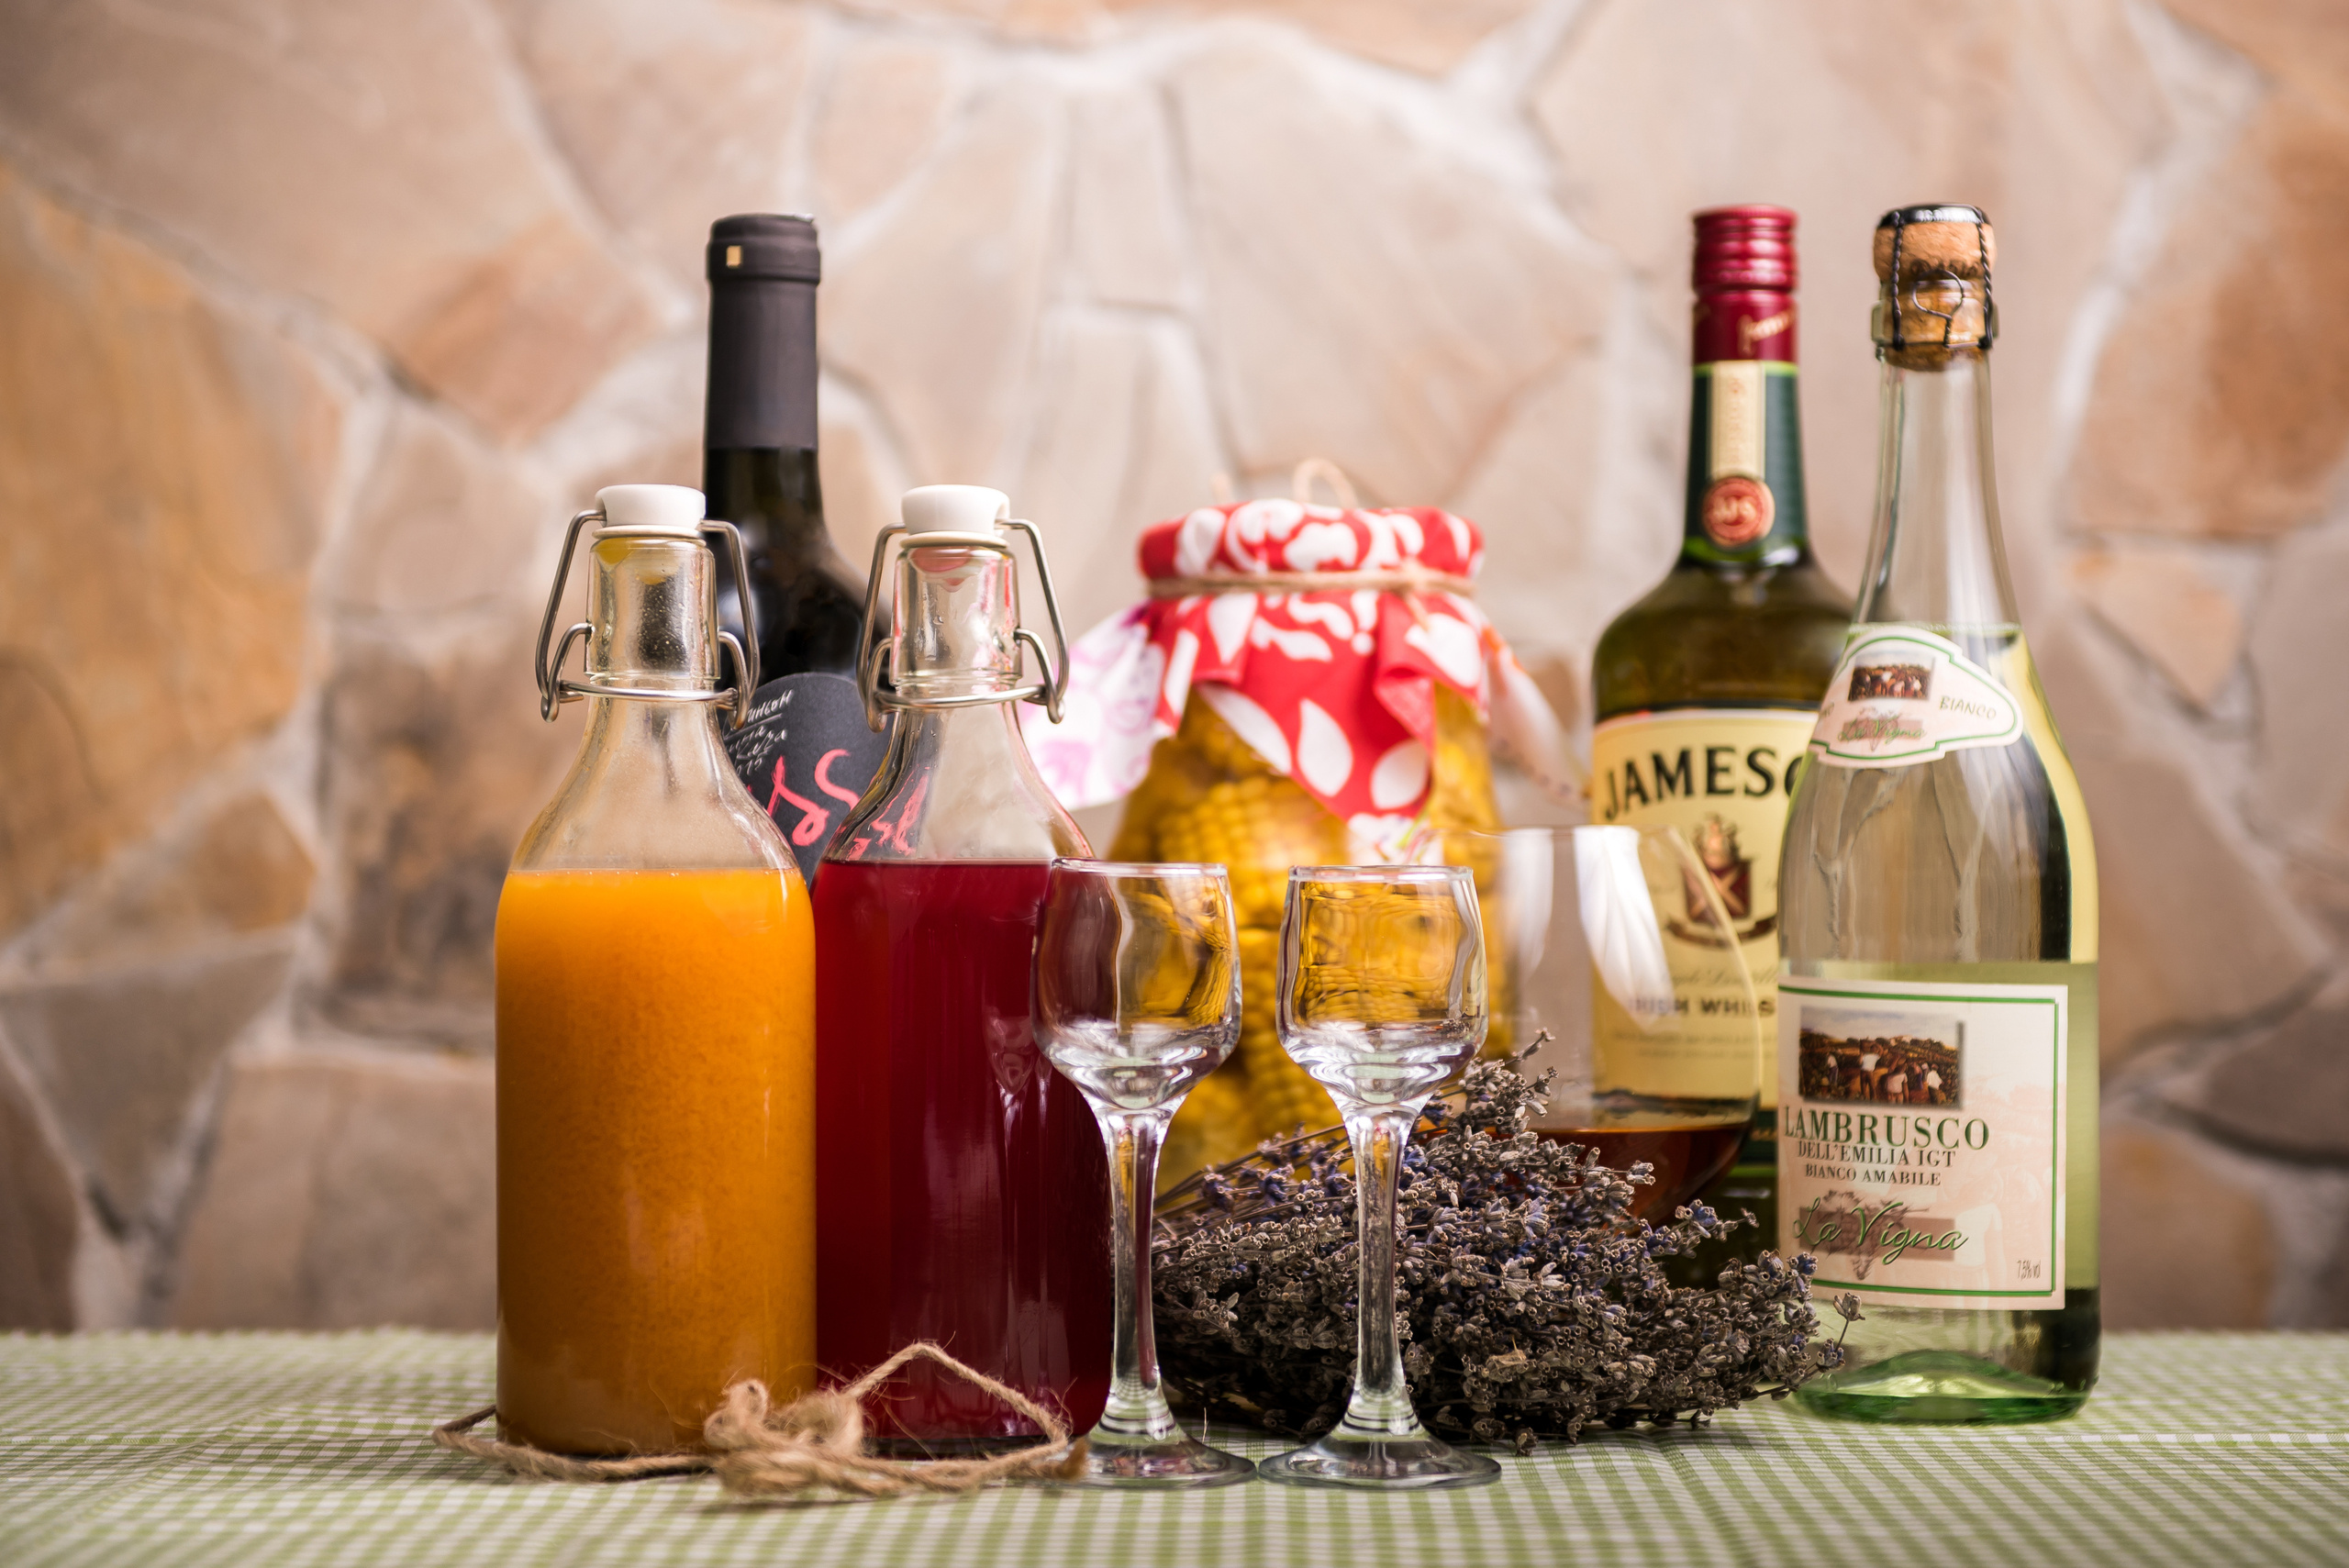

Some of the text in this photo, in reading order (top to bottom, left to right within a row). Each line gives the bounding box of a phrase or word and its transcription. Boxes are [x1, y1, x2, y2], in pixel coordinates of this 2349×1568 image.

[1939, 695, 1997, 721] BIANCO
[1837, 714, 1926, 745] La Vigna
[1700, 997, 1776, 1018] WHIS
[1784, 1105, 1990, 1151] LAMBRUSCO
[1798, 1140, 1956, 1168] DELL'EMILIA IGT
[1805, 1163, 1942, 1186] BIANCO AMABILE
[1792, 1195, 1970, 1266] La Vigna
